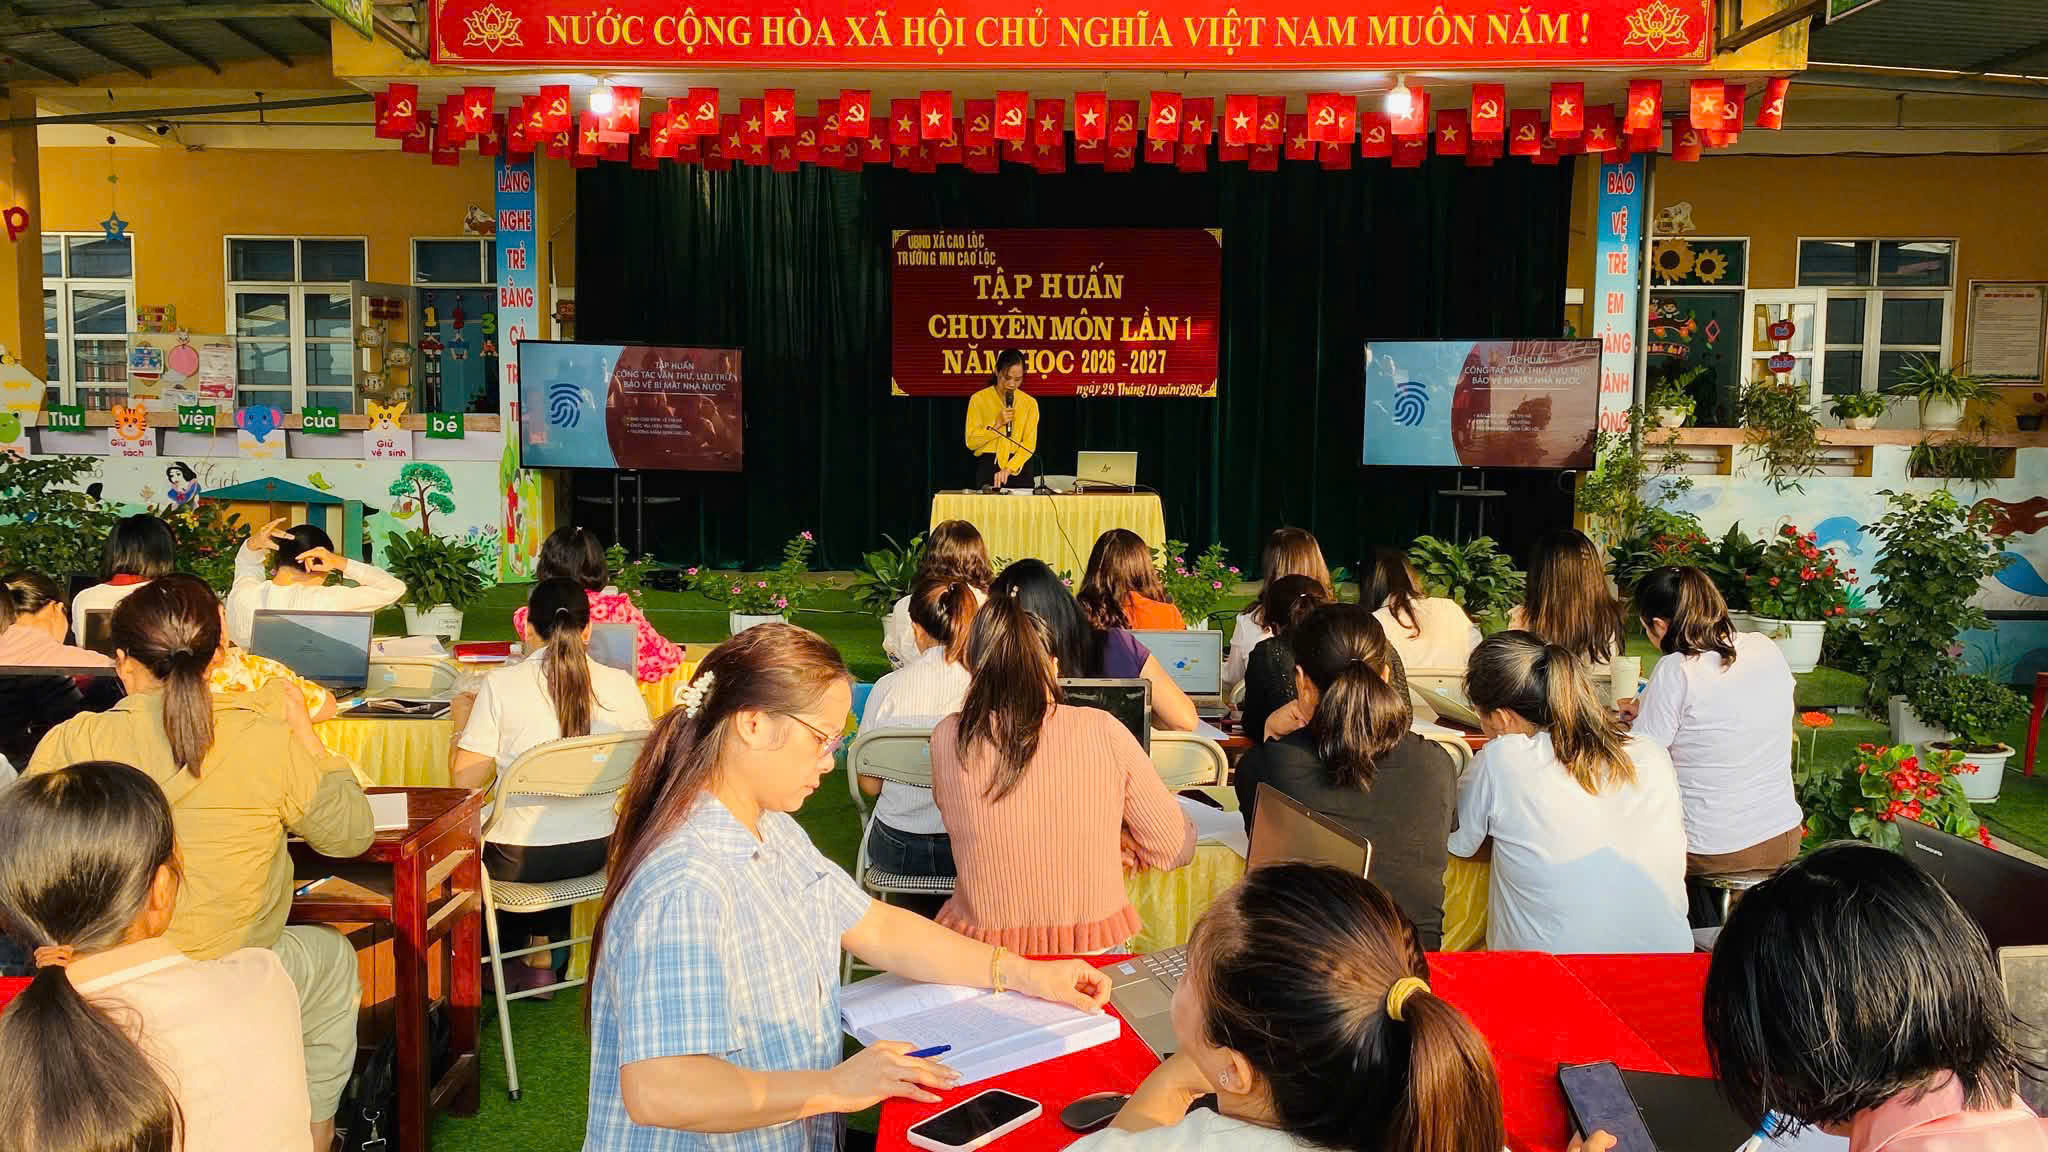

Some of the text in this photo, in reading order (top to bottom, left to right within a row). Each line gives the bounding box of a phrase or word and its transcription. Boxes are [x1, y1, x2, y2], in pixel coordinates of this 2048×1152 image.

[547, 8, 643, 45] NƯỚC
[654, 8, 751, 53] CỘNG
[763, 8, 835, 46] HÒA
[846, 10, 892, 46] XÃ
[904, 8, 965, 55] HỘI
[976, 8, 1048, 48] CHỦ
[1060, 9, 1172, 48] NGHĨA
[1184, 8, 1265, 56] VIỆT
[1276, 15, 1355, 47] NAM
[1368, 6, 1475, 46] MUÔN
[1487, 7, 1568, 45] NĂM
[1607, 163, 1635, 195] BẢO
[499, 209, 532, 232] NGHE
[1611, 206, 1628, 241] VỆ
[506, 240, 526, 270] TRẺ
[933, 230, 945, 249] XÃ
[946, 234, 965, 249] CAO
[967, 230, 985, 252] LỘC
[897, 248, 936, 266] TRƯỜNG
[939, 251, 955, 266] MN
[978, 247, 996, 268] LỘC
[1607, 244, 1628, 275] TRẺ
[500, 275, 534, 308] BẰNG
[973, 262, 1124, 306] TẬP HUẤN
[1607, 291, 1624, 314] EM
[928, 305, 1192, 342] CHUYÊN MÔN LẦN 1
[1597, 322, 1632, 353] ẰNG
[942, 343, 1002, 374] NĂM
[1019, 349, 1075, 380] HỌC
[1081, 349, 1116, 374] 2026
[1130, 349, 1167, 374] 2027
[1101, 383, 1115, 396] 29
[1145, 383, 1158, 397] 10
[1179, 383, 1203, 397] 2026
[1600, 366, 1629, 393] ÀNH
[48, 408, 458, 433] Thư viện của bé
